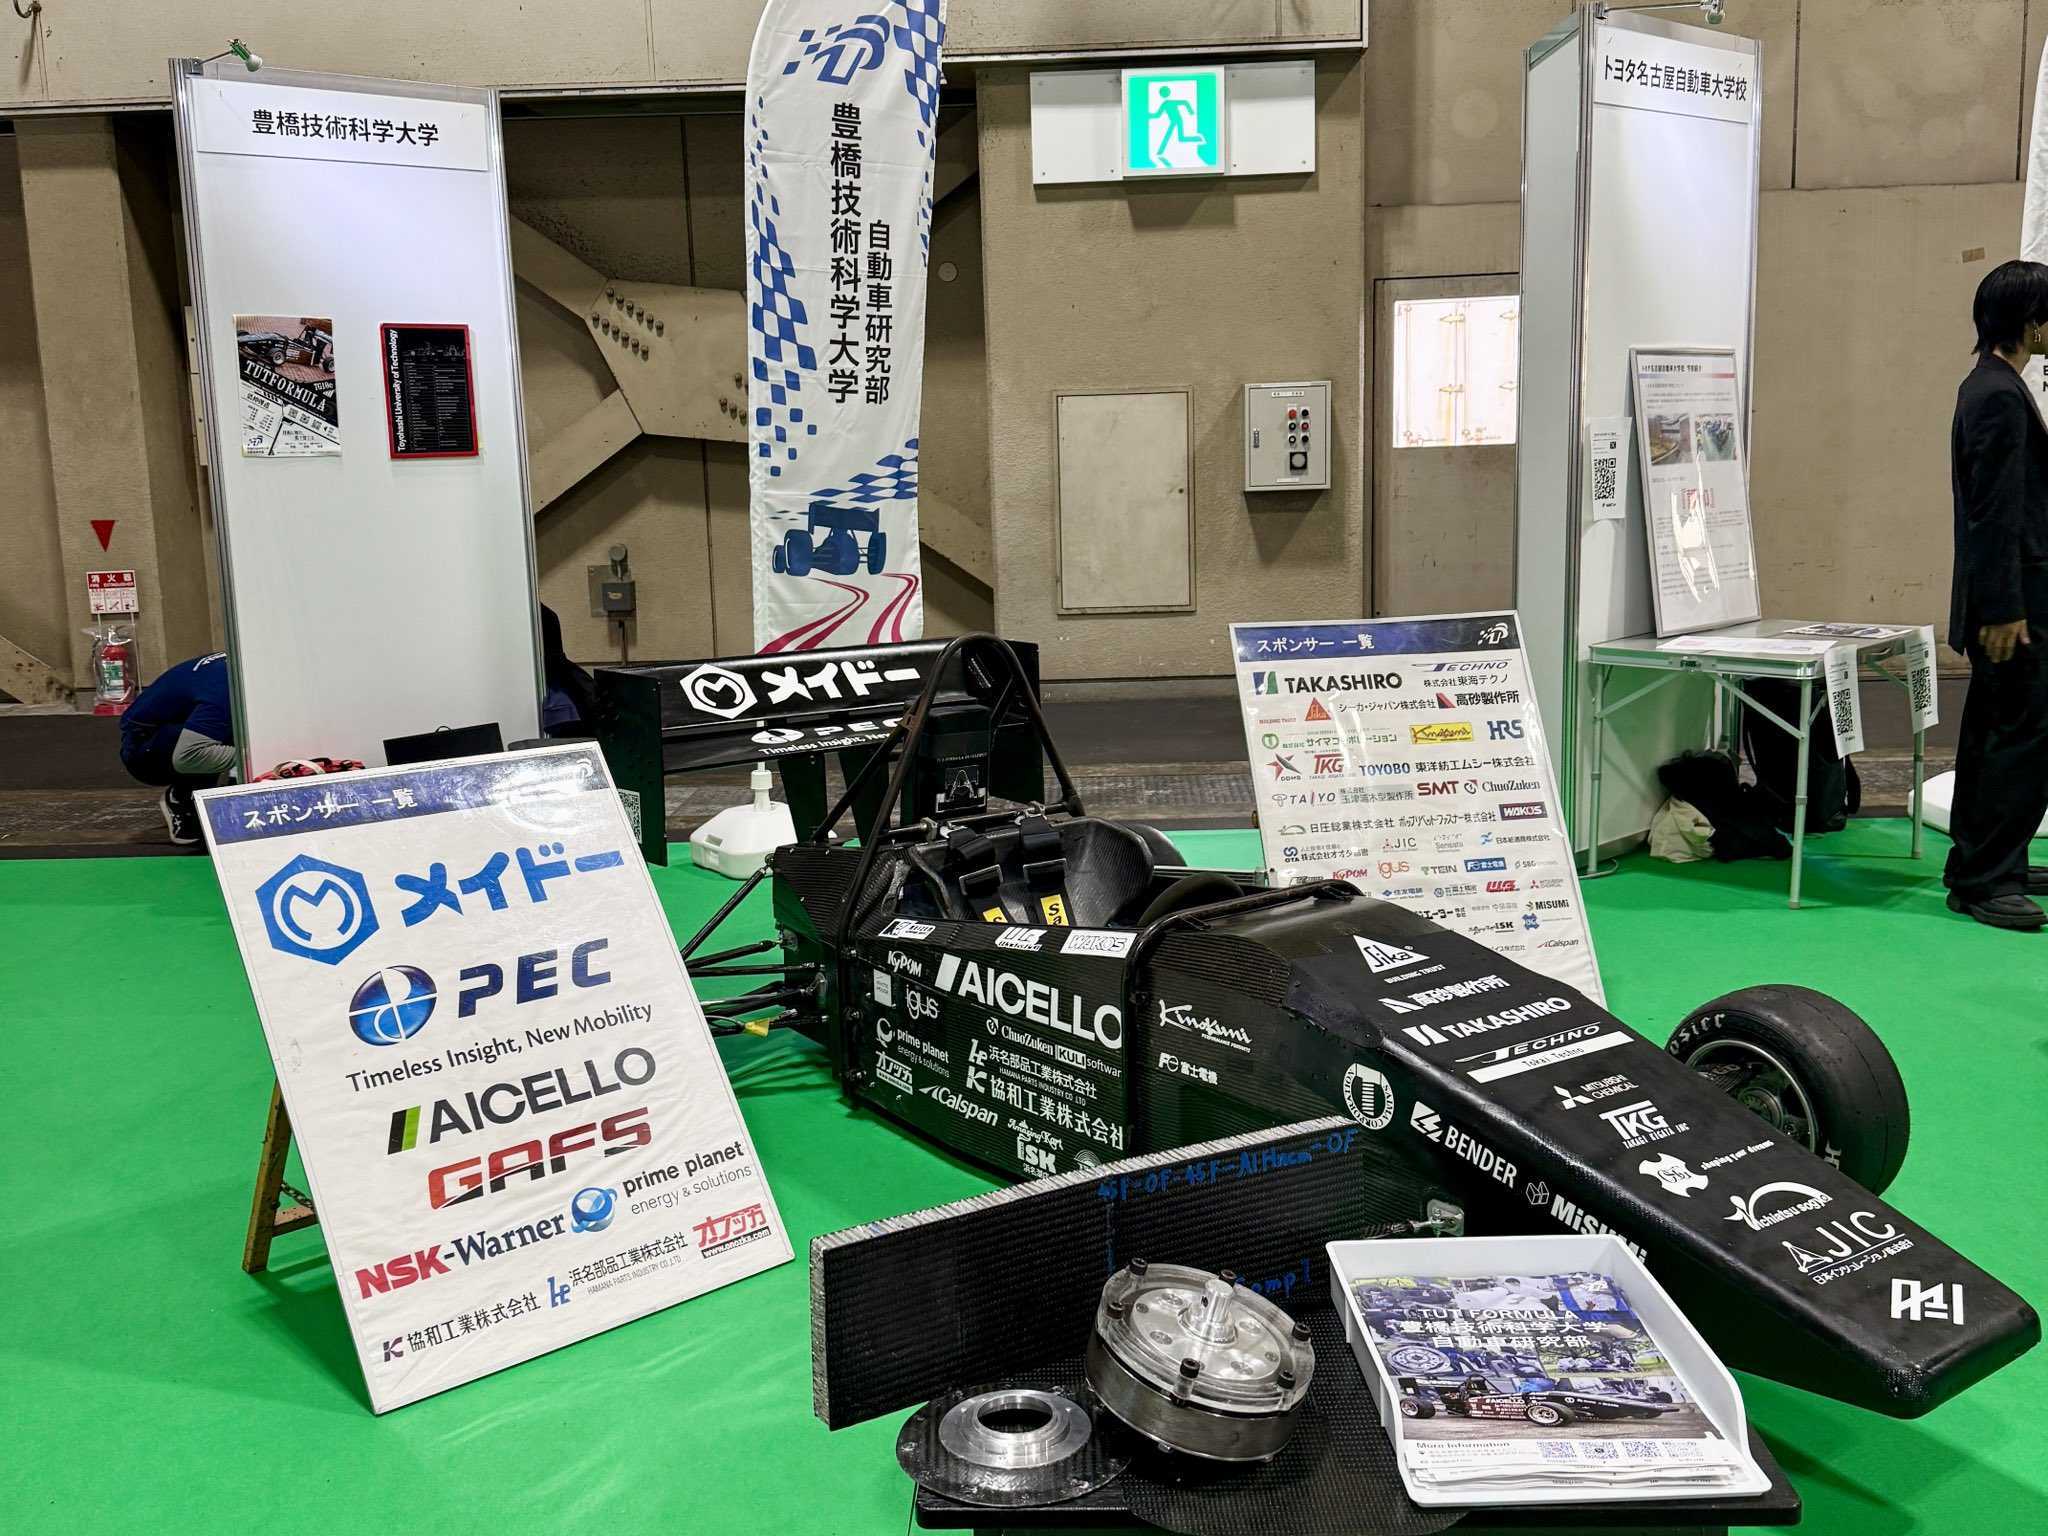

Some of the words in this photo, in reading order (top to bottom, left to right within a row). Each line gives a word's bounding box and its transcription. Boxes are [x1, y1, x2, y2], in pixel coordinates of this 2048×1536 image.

[1605, 55, 1747, 101] トヨタ名古屋自動車大学校
[252, 110, 439, 147] 豊橋技術科学大学
[828, 102, 862, 404] 豊橋技術科学大学
[865, 220, 893, 405] 自動車研究部
[389, 329, 399, 371] Technology
[244, 360, 327, 412] TUTFORMULA
[391, 371, 400, 379] of
[393, 380, 403, 415] University
[396, 416, 406, 451] Toyohashi
[1257, 637, 1334, 653] スポンサー
[1343, 634, 1374, 650] 一覧
[760, 660, 920, 705] メイドー
[1285, 672, 1402, 694] TAKASHIRO
[1424, 674, 1508, 688] 株式会社東海テクノ
[1455, 690, 1519, 706] 高砂製作所
[1487, 719, 1524, 740] HRS
[762, 743, 818, 755] Timeless
[1314, 754, 1345, 774] TKG
[1359, 763, 1410, 777] TOYOBO
[1482, 780, 1541, 792] ChuoZuken
[1417, 781, 1459, 796] SMT
[244, 791, 358, 830] スポンサー
[372, 788, 418, 810] 一覧
[1504, 805, 1542, 817] WAKOS
[1394, 837, 1416, 849] JIC
[394, 841, 625, 928] メイドー
[1069, 934, 1129, 952] WAKOS
[458, 938, 611, 1018] PEC
[906, 984, 939, 1020] igus
[958, 961, 1122, 1049] AICELLO
[1441, 997, 1572, 1039] TAKASHIRO
[346, 1058, 442, 1092] Timeless
[446, 1037, 522, 1067] Insight,
[525, 1023, 571, 1050] New
[574, 1004, 652, 1036] Mobility
[897, 1028, 920, 1048] prime
[922, 1041, 949, 1063] planet
[1001, 1024, 1054, 1056] ChuoZuken
[1522, 1055, 1550, 1068] Tokai
[1551, 1046, 1585, 1060] Techno
[989, 1045, 1097, 1100] 浜名部品工業株式会社
[999, 1067, 1021, 1082] HAMANA
[1021, 1074, 1038, 1088] PARTS
[1038, 1082, 1065, 1099] INDUSTRY
[1087, 1056, 1121, 1078] softwar
[1580, 1074, 1630, 1092] MITSUBISHI
[430, 1047, 656, 1145] AICELLO
[938, 1086, 999, 1126] Calspan
[1591, 1082, 1640, 1100] CHEMICAL
[991, 1074, 1123, 1151] 協和工業株式会社
[1598, 1100, 1670, 1141] TKG
[428, 1106, 652, 1210] GAFS
[1444, 1125, 1518, 1190] BENDER
[1622, 1136, 1649, 1150] TAKAGI
[622, 1165, 679, 1198] prime
[685, 1141, 744, 1177] planet
[631, 1190, 680, 1215] energy
[682, 1187, 691, 1198] &
[693, 1164, 752, 1194] solutions
[1815, 1211, 1896, 1258] JIC
[355, 1213, 566, 1299] NSK-Warner
[568, 1231, 688, 1287] 浜名部品工業株式会社
[407, 1291, 541, 1352] 協和工業株式会社
[1400, 1321, 1609, 1334] 豊橋技術科学大学
[1418, 1308, 1462, 1319] TUT
[1470, 1308, 1581, 1320] FORMULA
[1433, 1335, 1592, 1353] 自動車研究部
